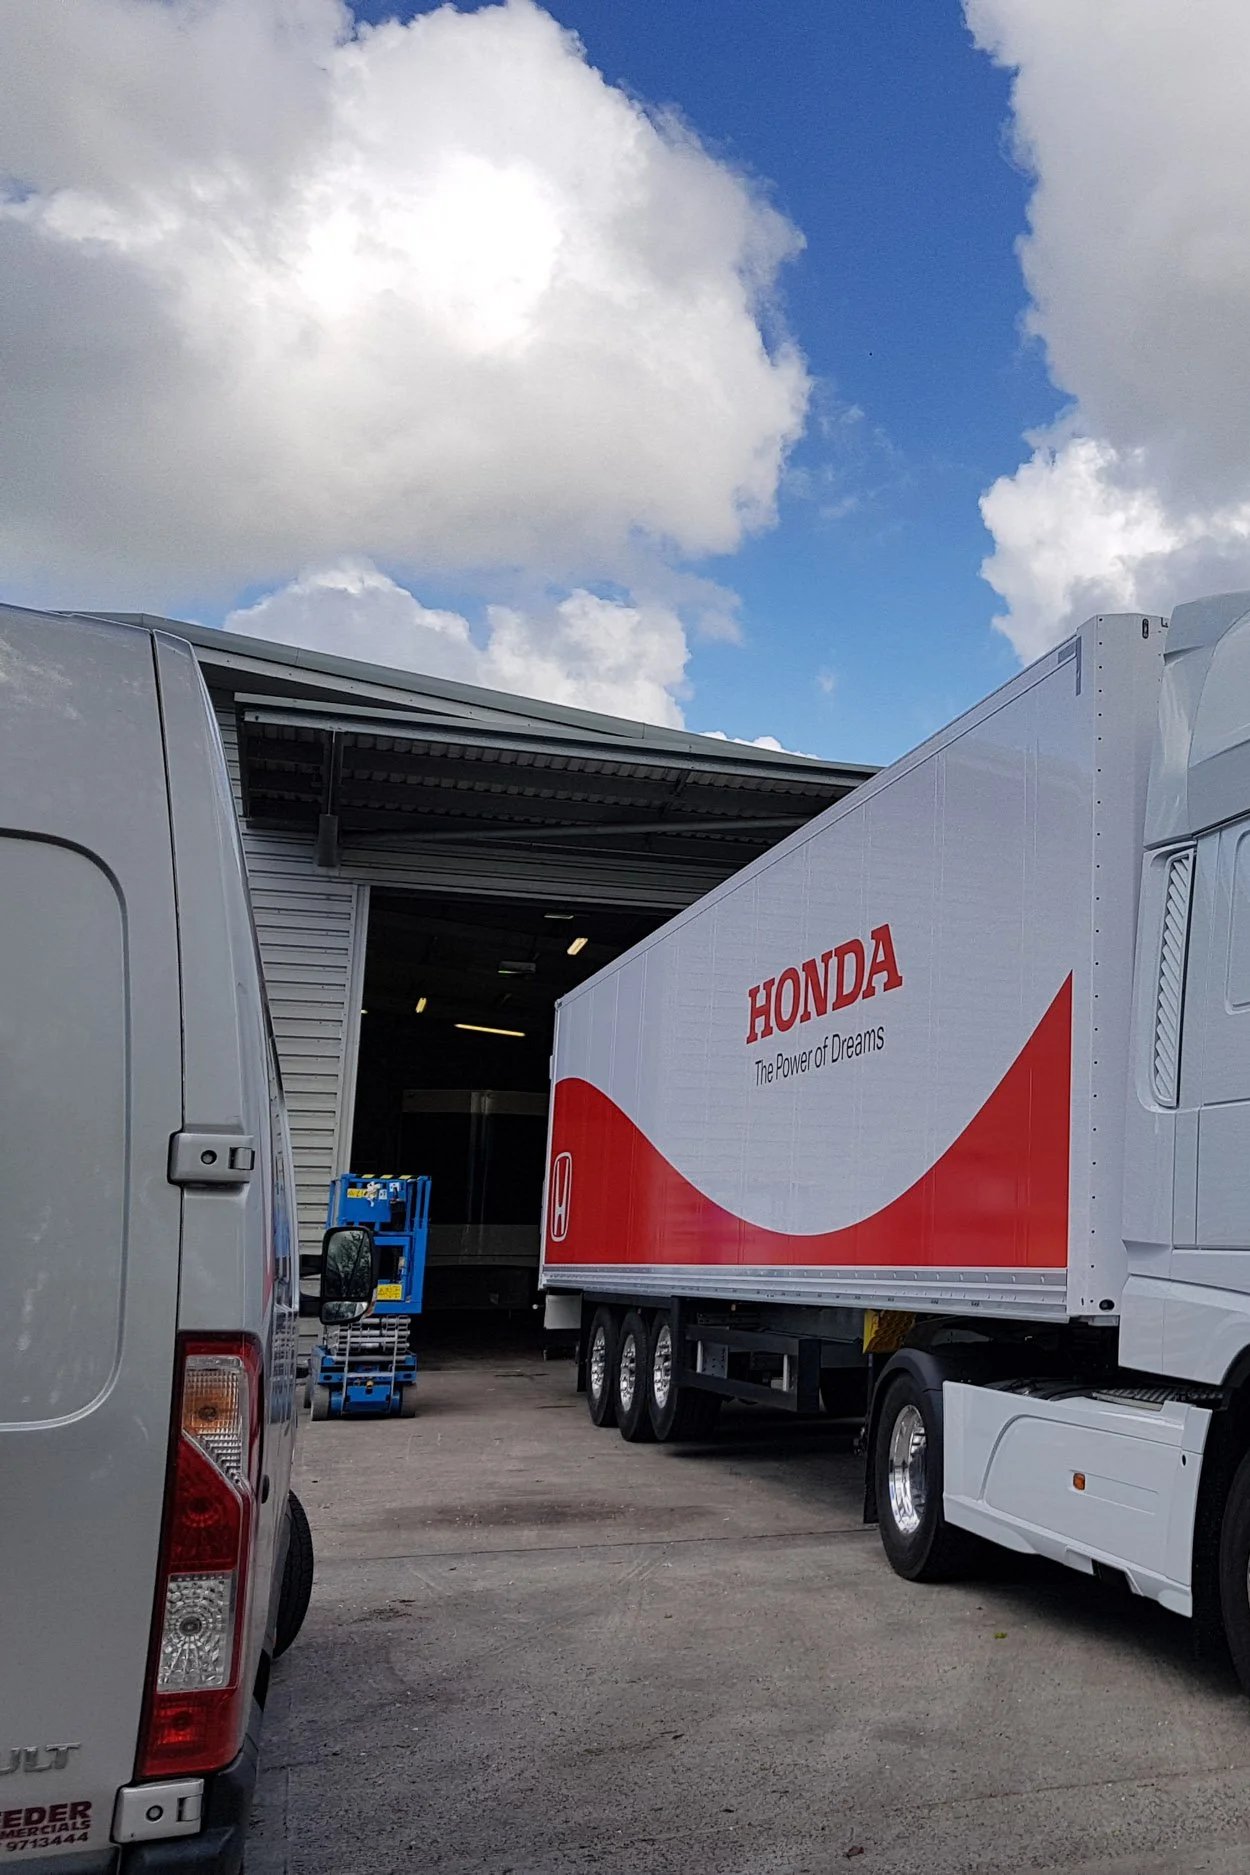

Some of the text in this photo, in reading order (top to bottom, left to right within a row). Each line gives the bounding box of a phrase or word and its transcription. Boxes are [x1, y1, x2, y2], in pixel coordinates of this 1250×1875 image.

[746, 923, 903, 1044] HONDA
[755, 1026, 885, 1087] The Power of Dreams
[0, 1801, 92, 1828] EDER
[0, 1820, 91, 1839] MERCIALS
[6, 1832, 89, 1852] 9713444
